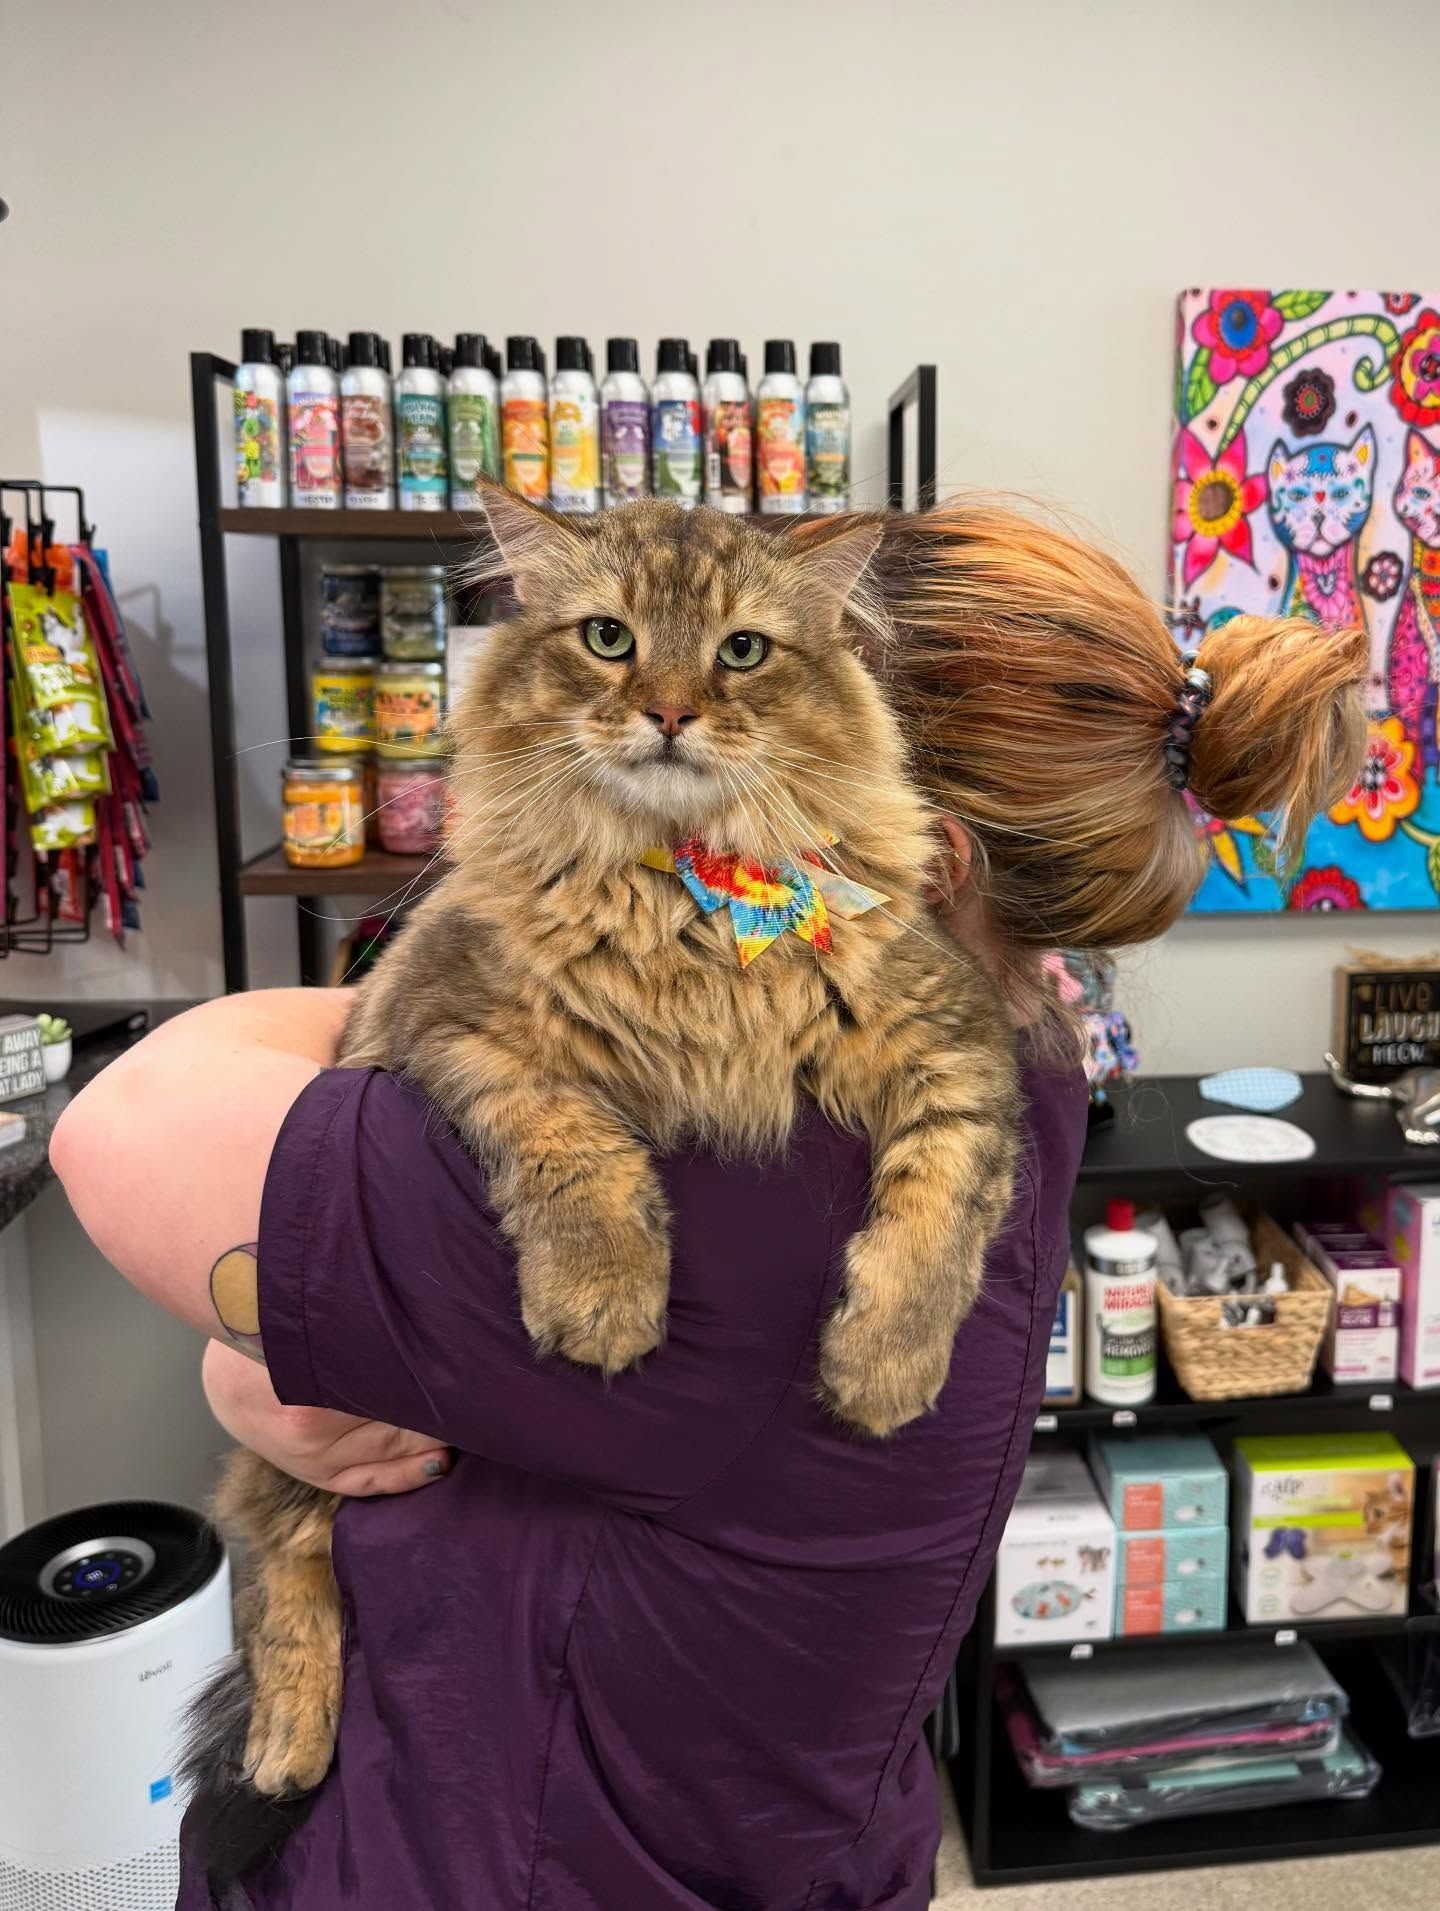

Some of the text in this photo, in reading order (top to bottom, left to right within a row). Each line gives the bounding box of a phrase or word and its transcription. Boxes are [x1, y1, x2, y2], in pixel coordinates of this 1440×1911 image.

[4, 1029, 41, 1054] AWAY
[31, 1049, 42, 1069] A
[1372, 1042, 1424, 1065] MEOW
[13, 1072, 43, 1092] LADY
